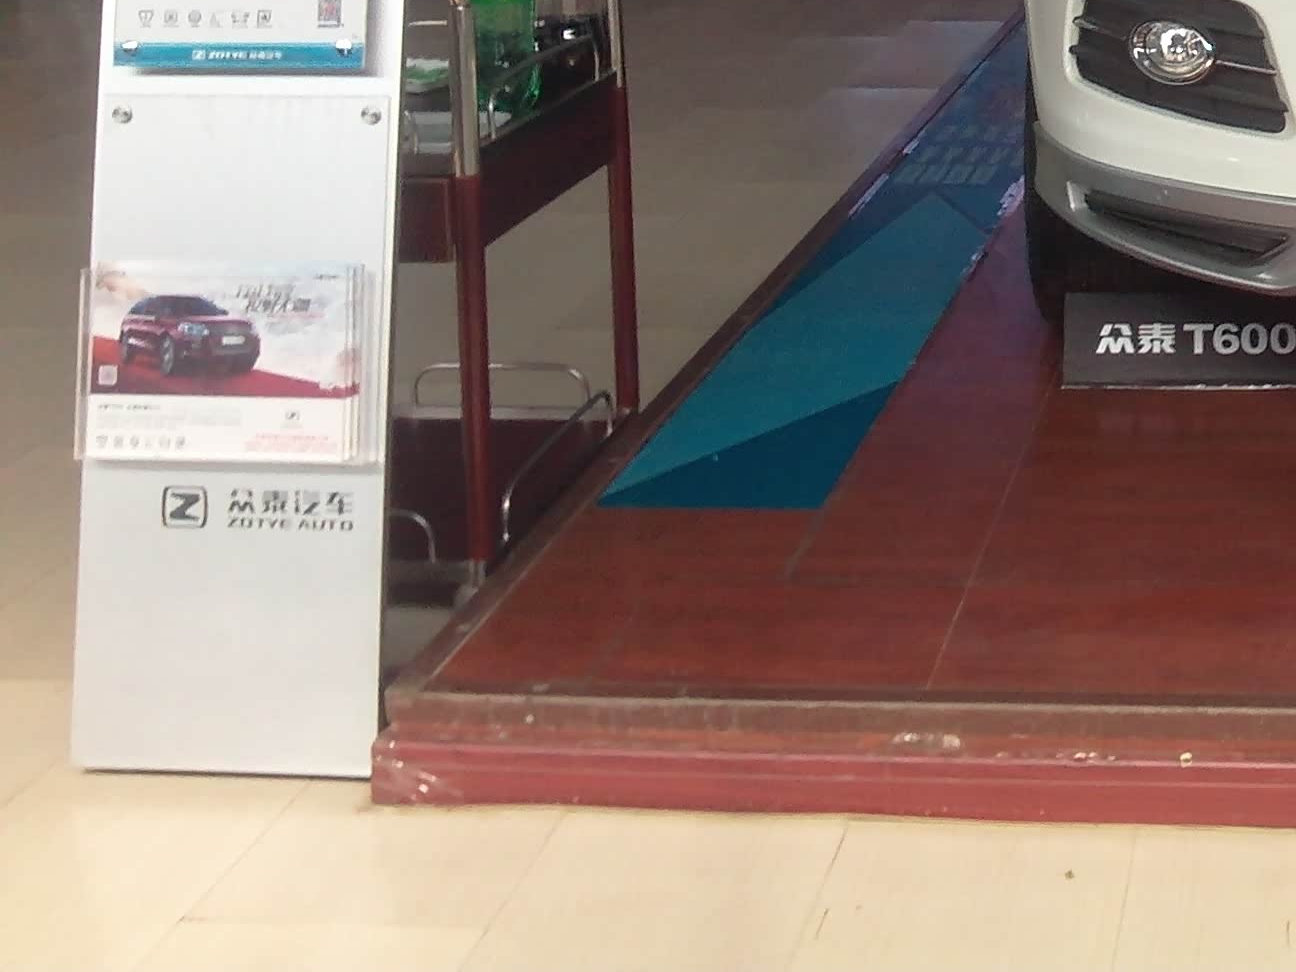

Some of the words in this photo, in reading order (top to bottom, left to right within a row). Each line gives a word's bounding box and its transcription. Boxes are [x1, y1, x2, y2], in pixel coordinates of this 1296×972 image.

[1095, 323, 1176, 354] 众泰
[1183, 323, 1296, 355] T600
[228, 487, 355, 515] 众泰汽车
[297, 518, 355, 532] AUTO
